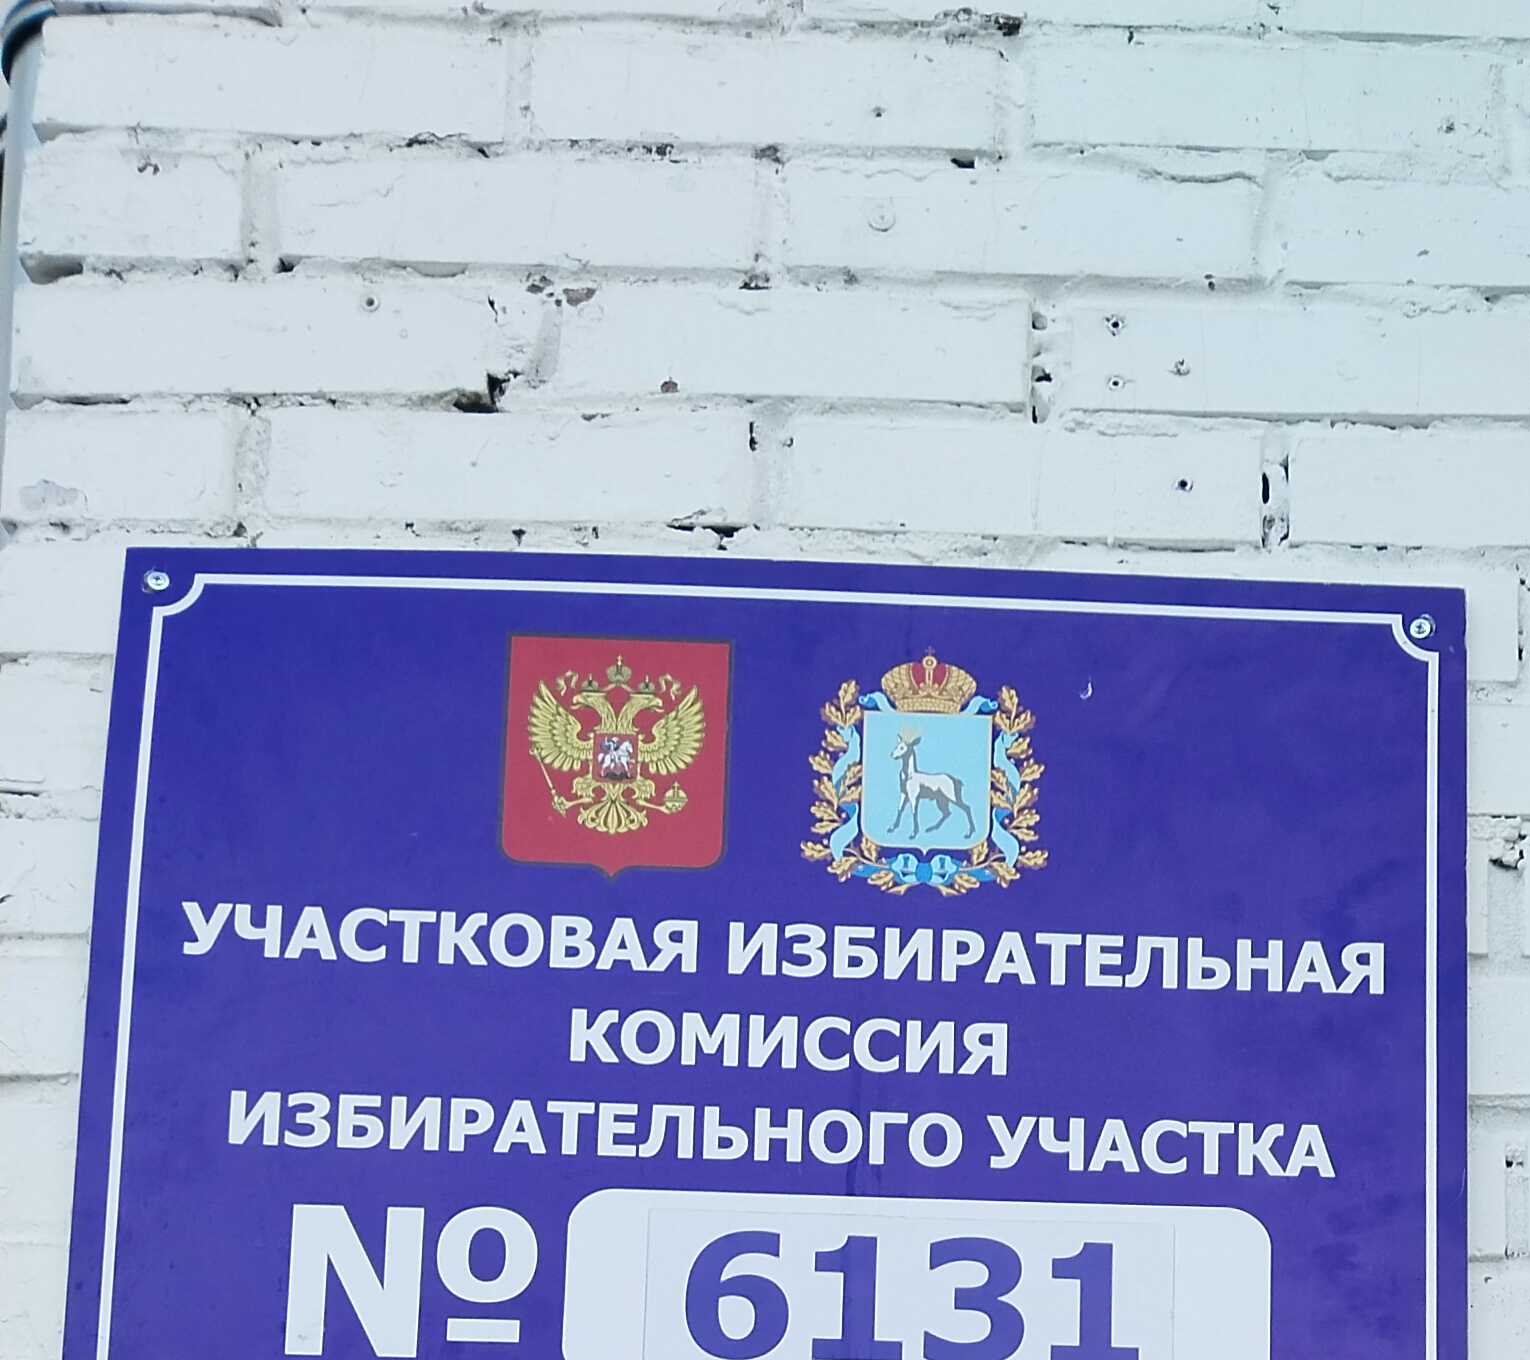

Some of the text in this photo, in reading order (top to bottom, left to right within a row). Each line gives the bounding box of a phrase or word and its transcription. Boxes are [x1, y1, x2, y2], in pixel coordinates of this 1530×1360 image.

[181, 901, 1386, 996] УЧАСТКОВАЯ ИЗБИРАТЕЛЬНАЯ
[568, 1007, 1010, 1077] КОМИССИЯ
[227, 1089, 1336, 1179] ИЗБИРАТЕЛЬНОГО УЧАСТКА
[283, 1202, 539, 1360] №
